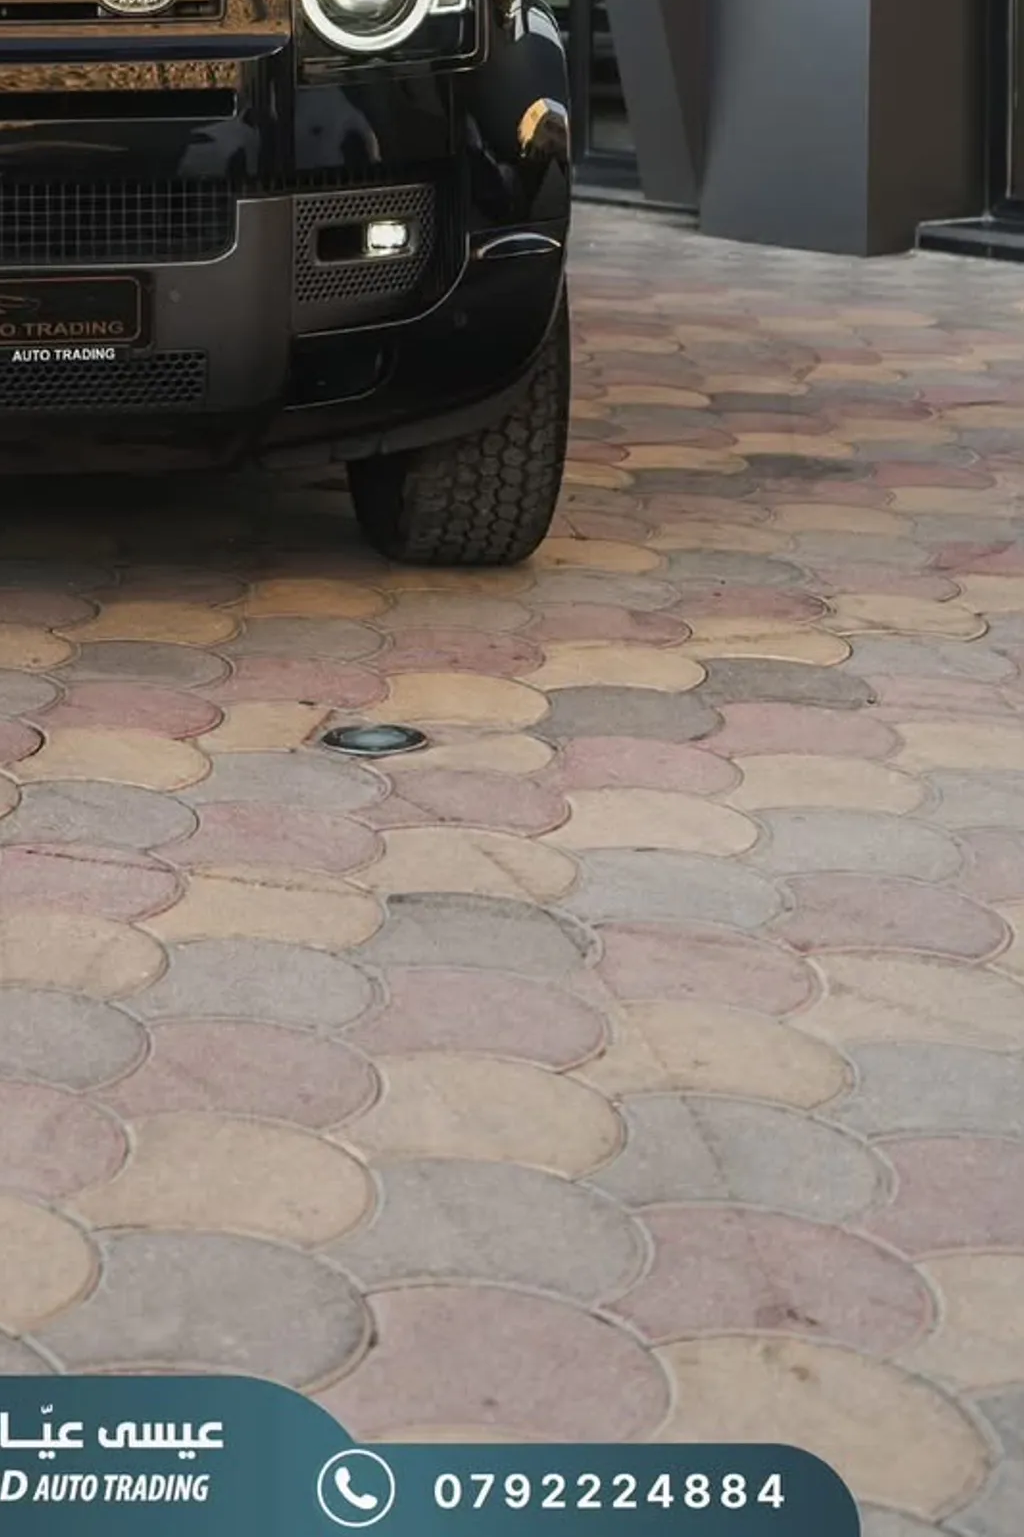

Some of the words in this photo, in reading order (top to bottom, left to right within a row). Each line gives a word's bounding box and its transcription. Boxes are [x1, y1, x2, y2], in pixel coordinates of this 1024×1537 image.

[22, 321, 125, 336] TRADING
[11, 349, 51, 362] AUTO
[53, 347, 116, 361] TRADING
